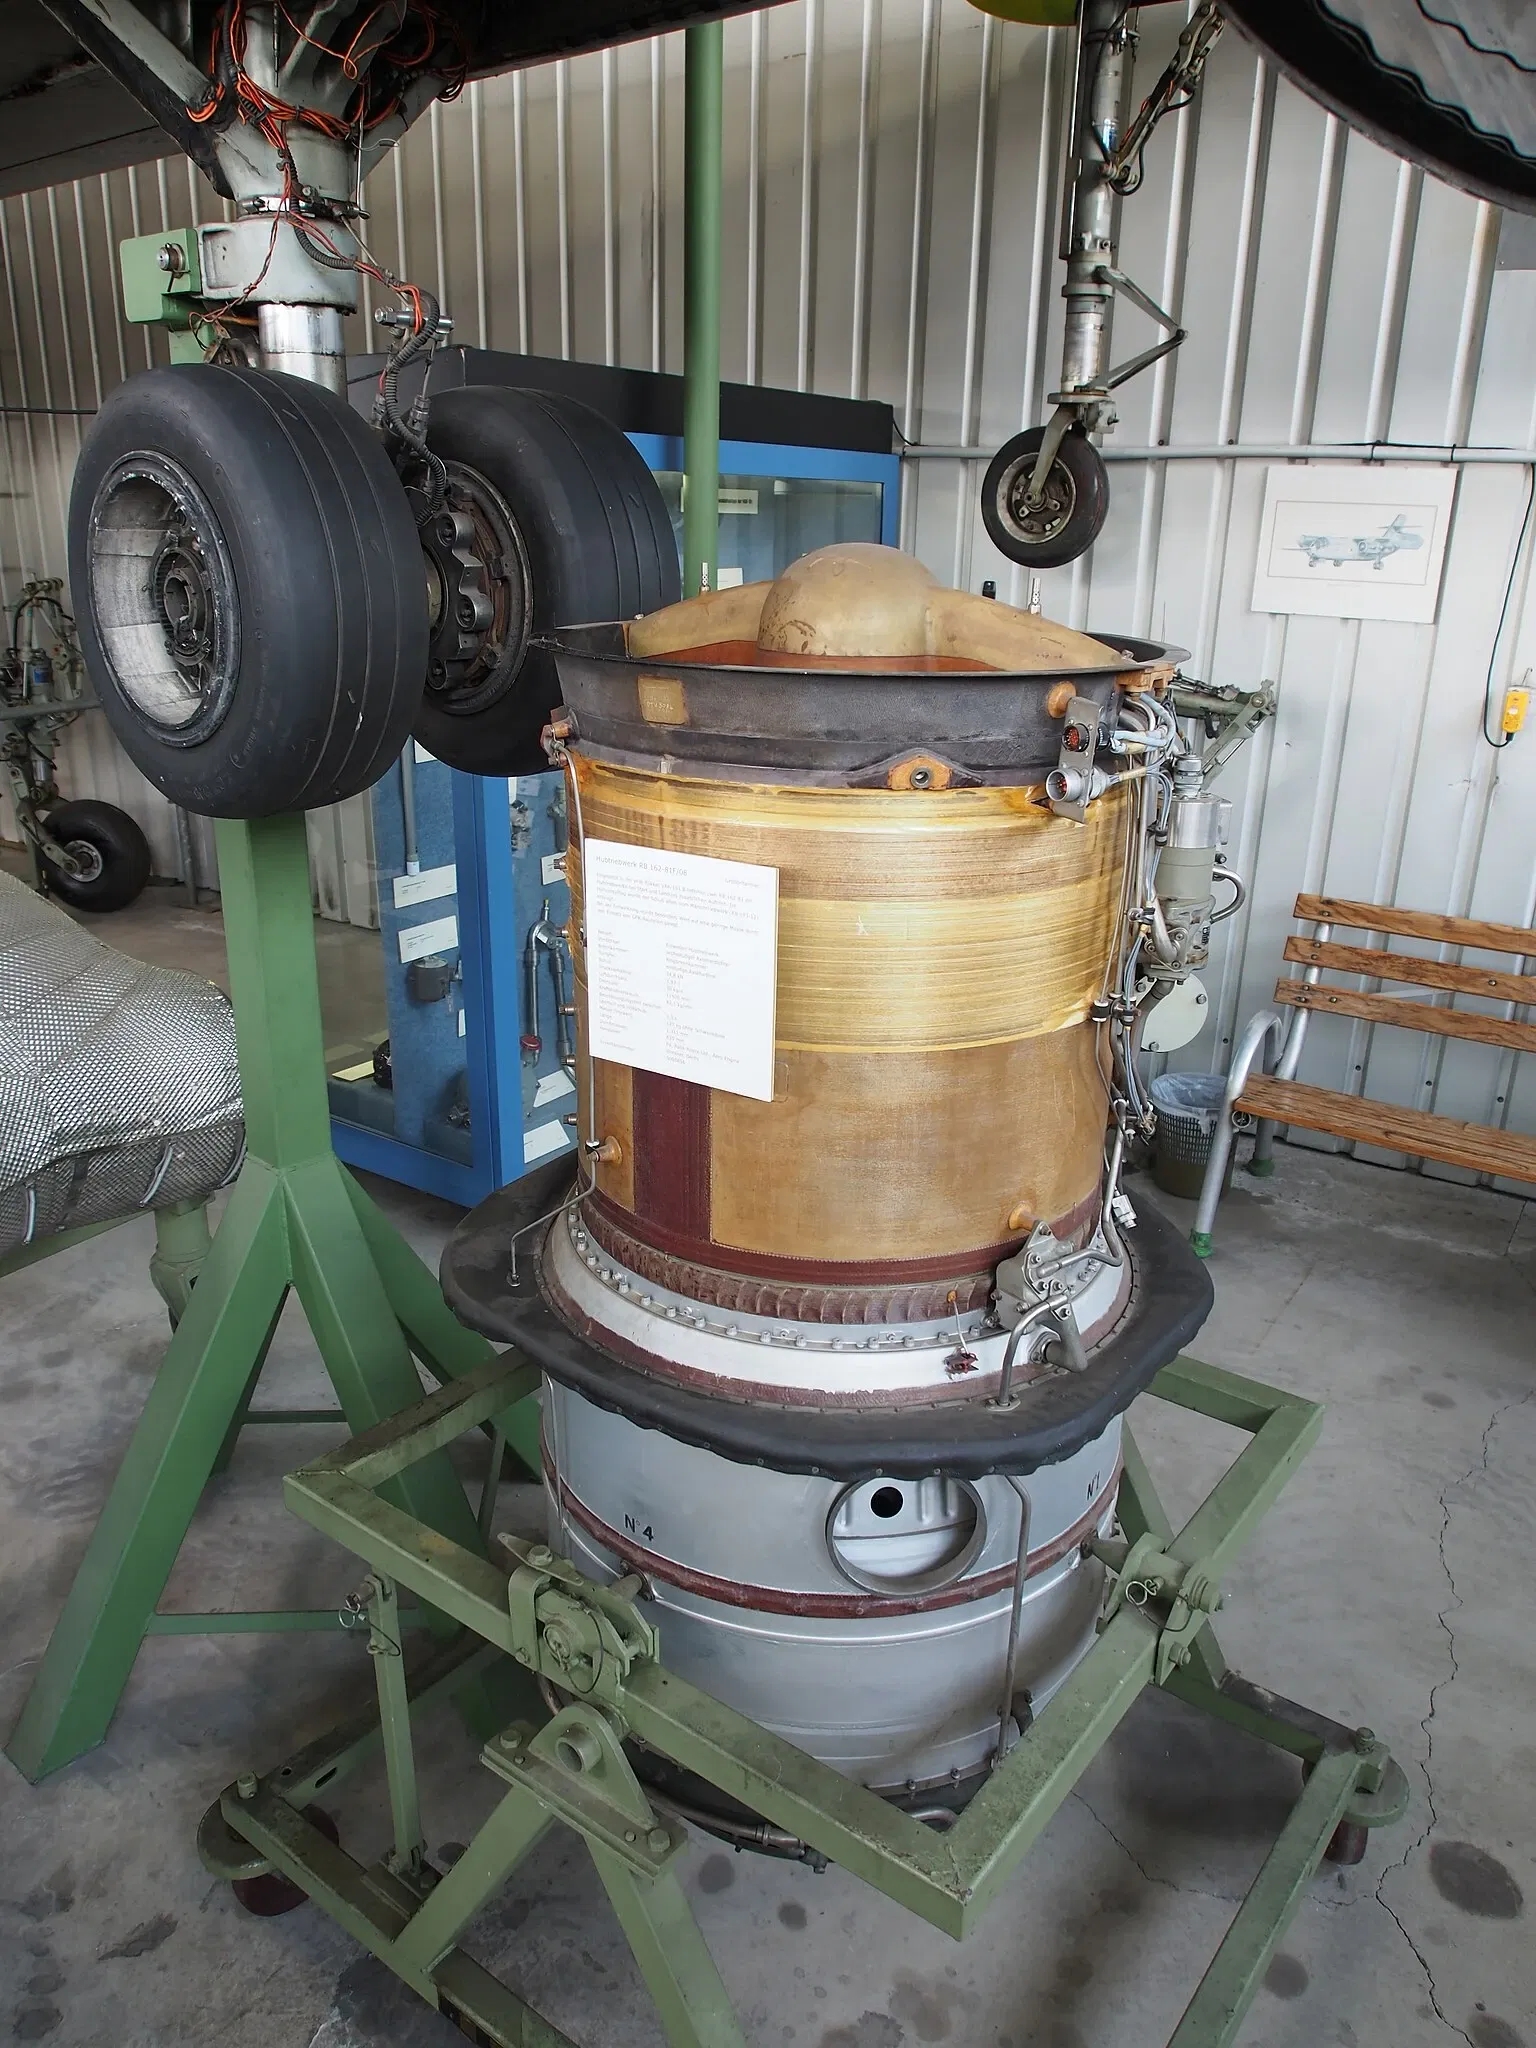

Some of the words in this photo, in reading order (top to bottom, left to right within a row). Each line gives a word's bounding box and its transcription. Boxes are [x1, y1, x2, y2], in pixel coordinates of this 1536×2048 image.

[596, 856, 637, 868] Hubtriebwerk
[639, 862, 648, 870] RB
[642, 1525, 654, 1542] 4
